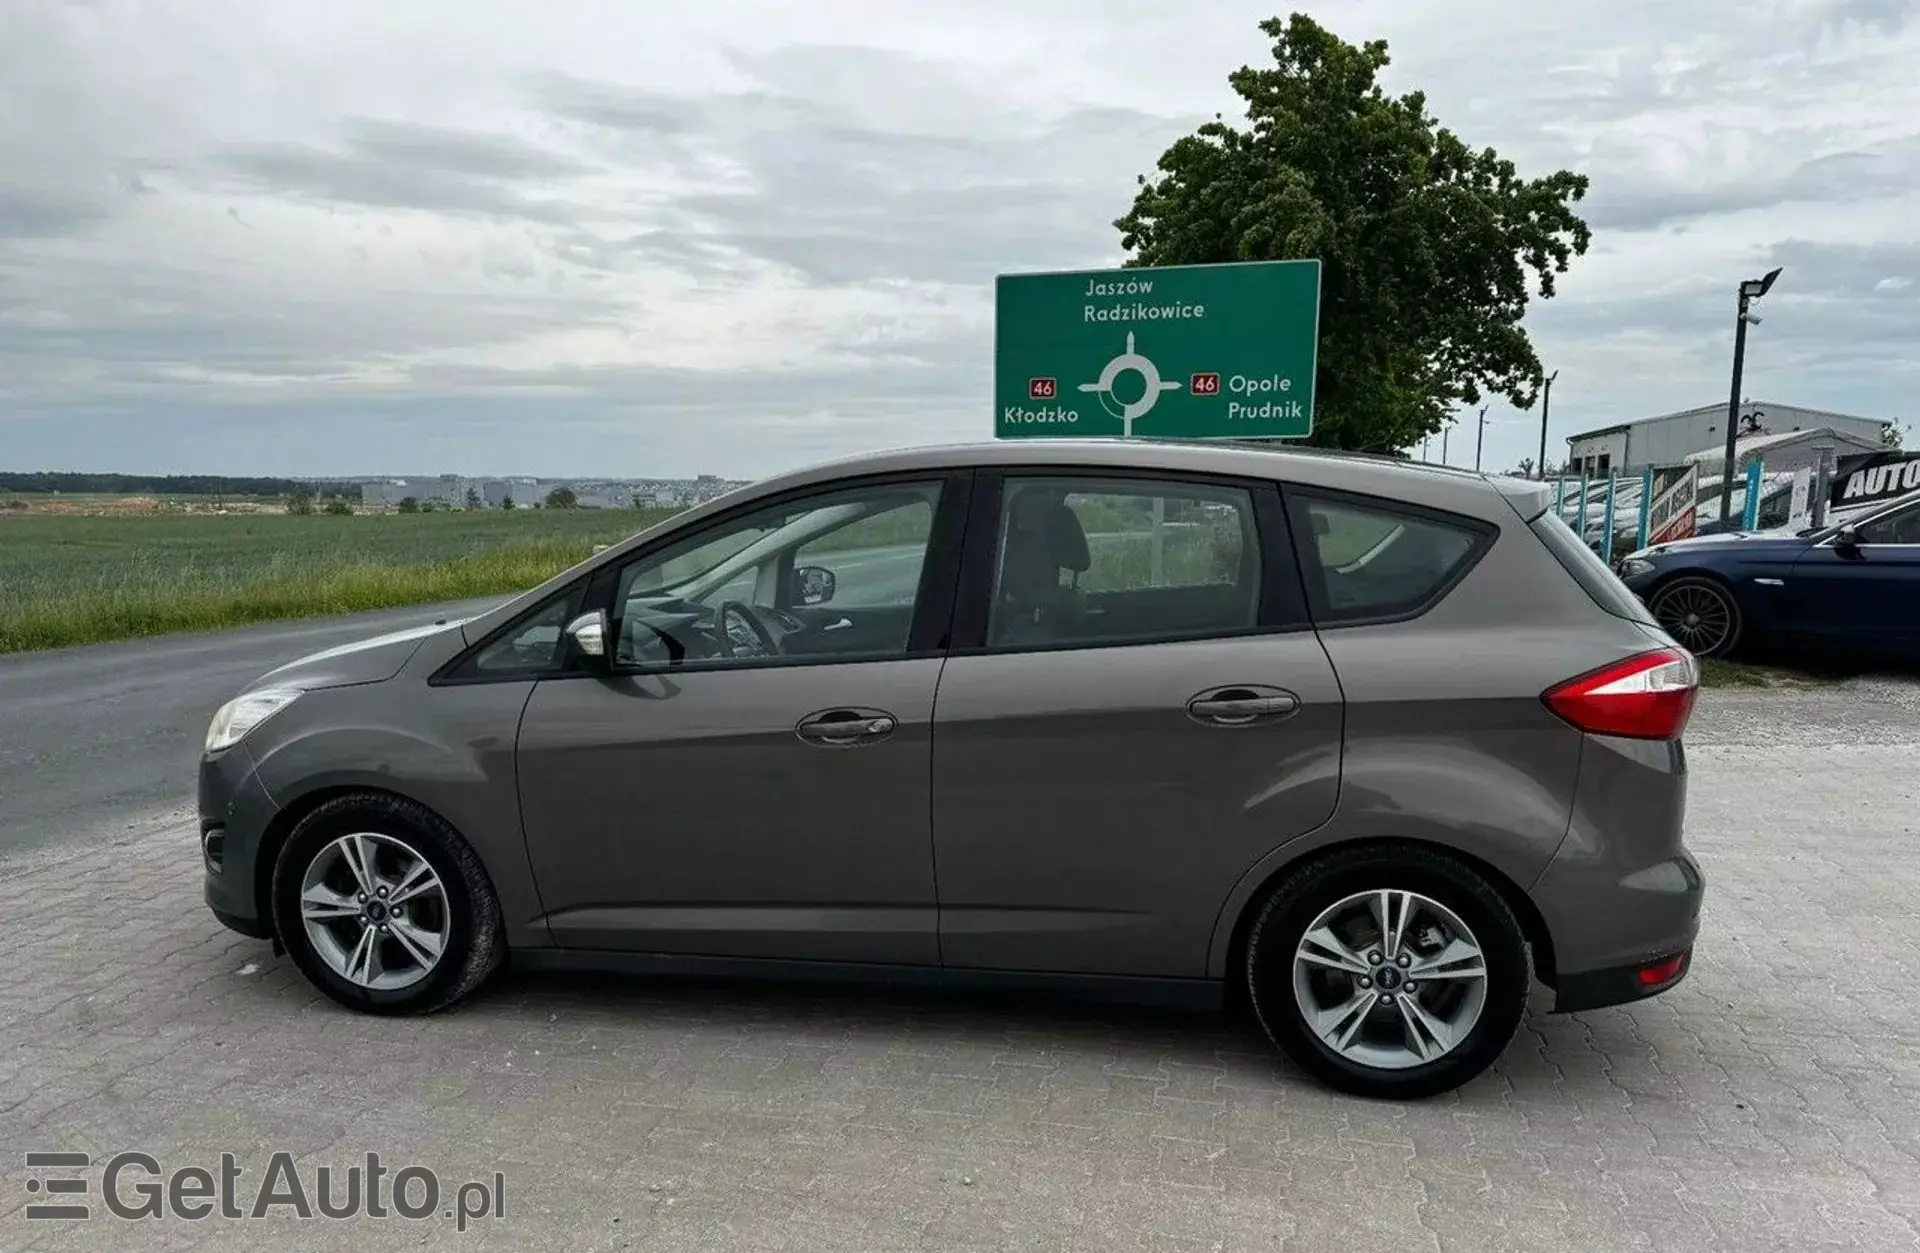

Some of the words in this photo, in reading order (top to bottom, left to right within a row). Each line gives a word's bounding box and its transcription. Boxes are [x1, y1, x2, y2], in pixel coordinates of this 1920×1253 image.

[1085, 277, 1153, 297] Jaszów
[1084, 301, 1205, 322] Radzikowice
[1033, 381, 1052, 396] 46
[1195, 377, 1215, 392] 46
[1229, 374, 1292, 397] Opole
[1004, 406, 1079, 424] Kłodzko
[1228, 401, 1302, 420] Prudnik
